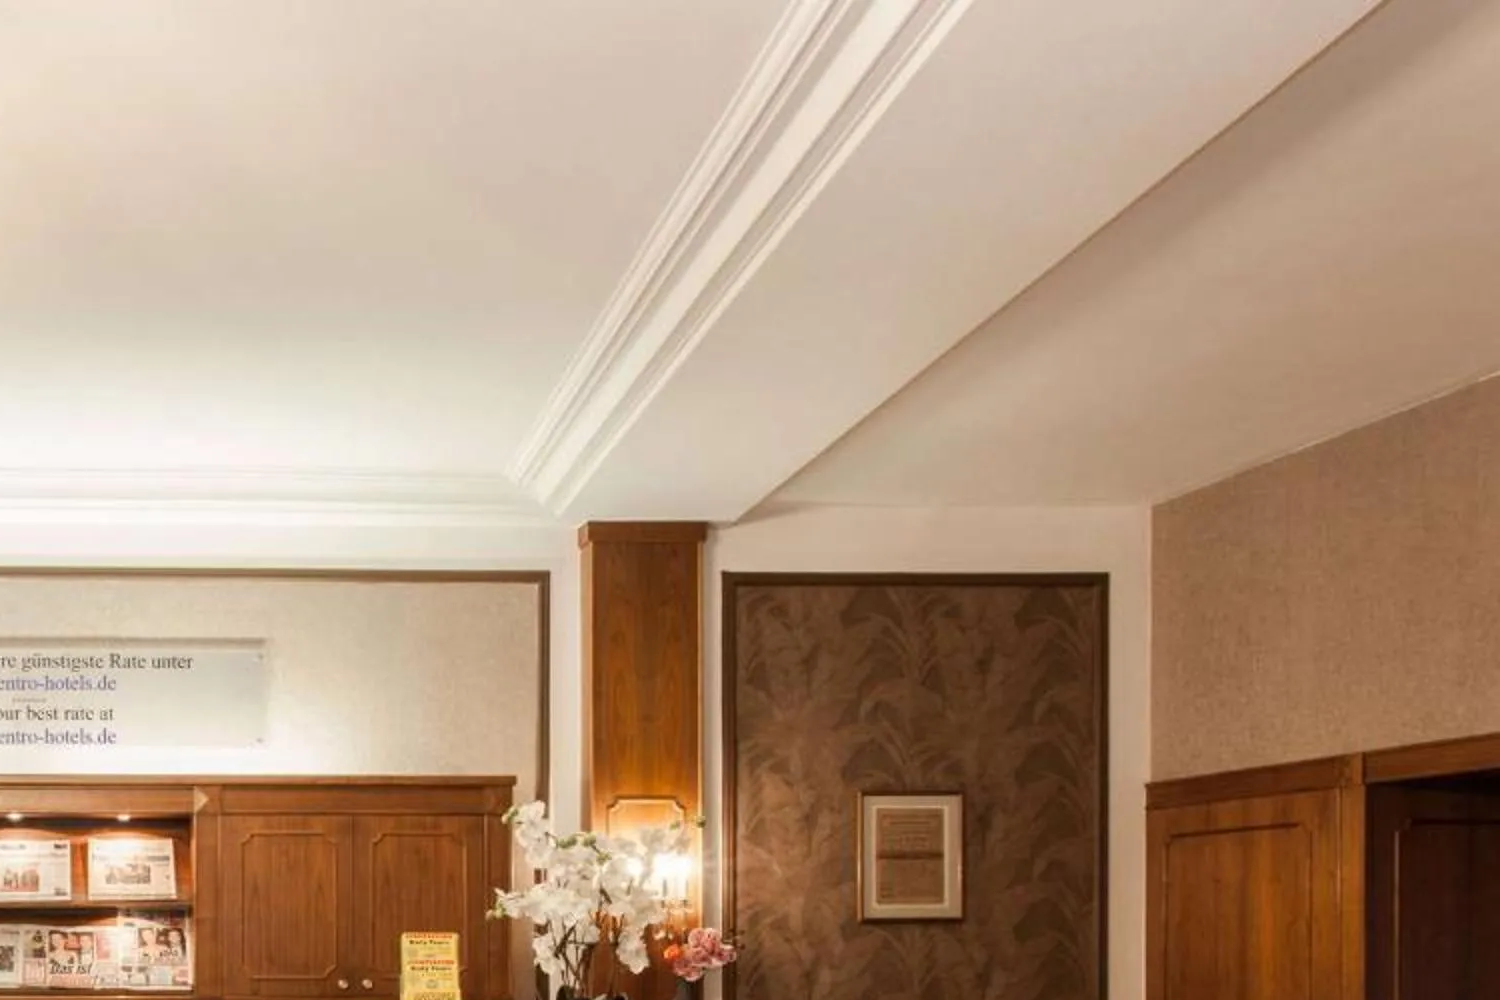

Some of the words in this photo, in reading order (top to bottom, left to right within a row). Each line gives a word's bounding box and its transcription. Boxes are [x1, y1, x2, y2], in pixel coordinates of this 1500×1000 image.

[20, 652, 105, 672] günstigste
[108, 652, 146, 669] Rate
[151, 656, 194, 669] unter
[26, 704, 59, 721] best
[64, 707, 95, 721] rate
[99, 706, 114, 721] at
